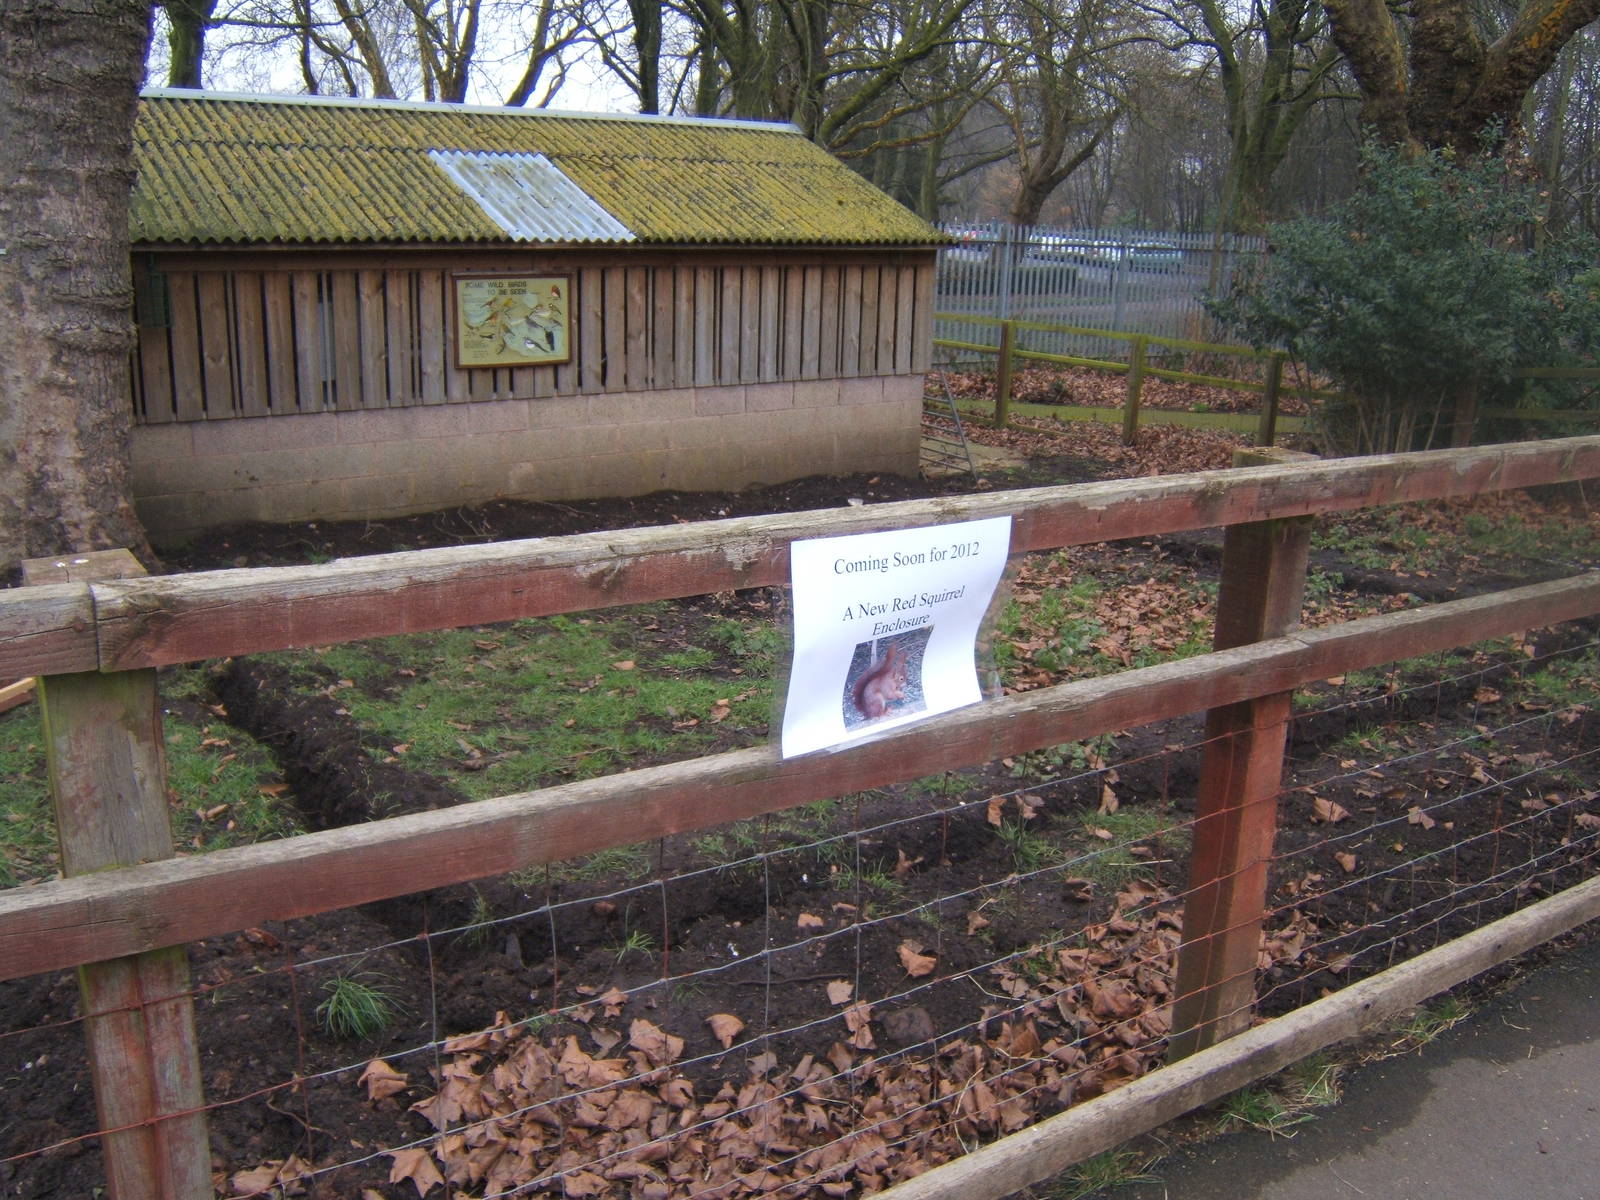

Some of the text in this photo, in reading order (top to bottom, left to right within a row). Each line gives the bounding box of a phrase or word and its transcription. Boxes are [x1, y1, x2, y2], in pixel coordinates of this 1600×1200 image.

[487, 280, 504, 288] WILD
[508, 280, 527, 288] BIRDS
[834, 541, 980, 574] Coming Soon for 2012
[842, 585, 965, 621] A New Red Squirrel
[872, 613, 930, 636] Enclosure
